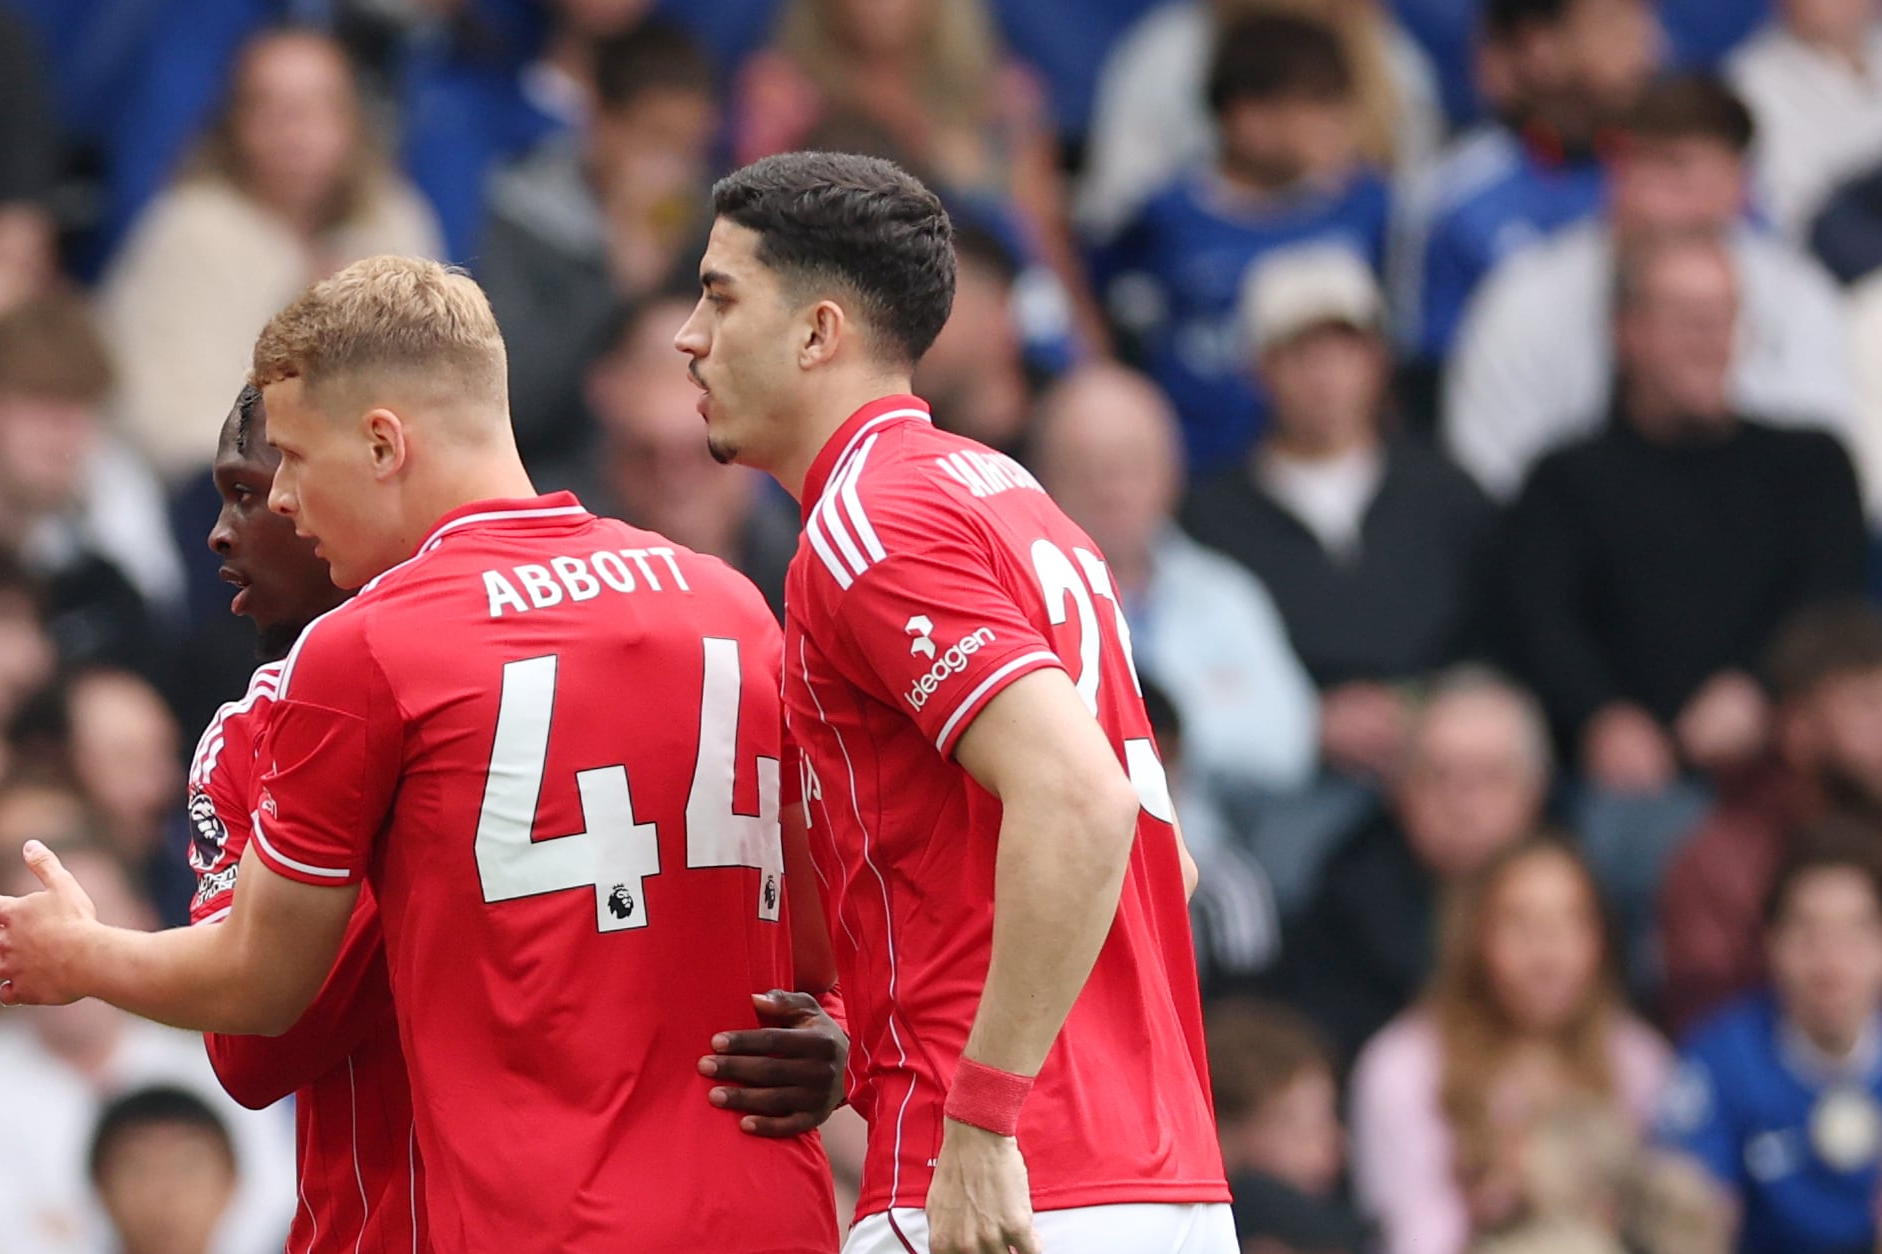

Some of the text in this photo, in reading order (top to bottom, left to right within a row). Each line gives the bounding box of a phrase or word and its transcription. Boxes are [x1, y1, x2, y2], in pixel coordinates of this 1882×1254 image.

[481, 547, 691, 618] ABBOTT
[904, 625, 997, 713] Ideagen
[474, 636, 786, 934] 44
